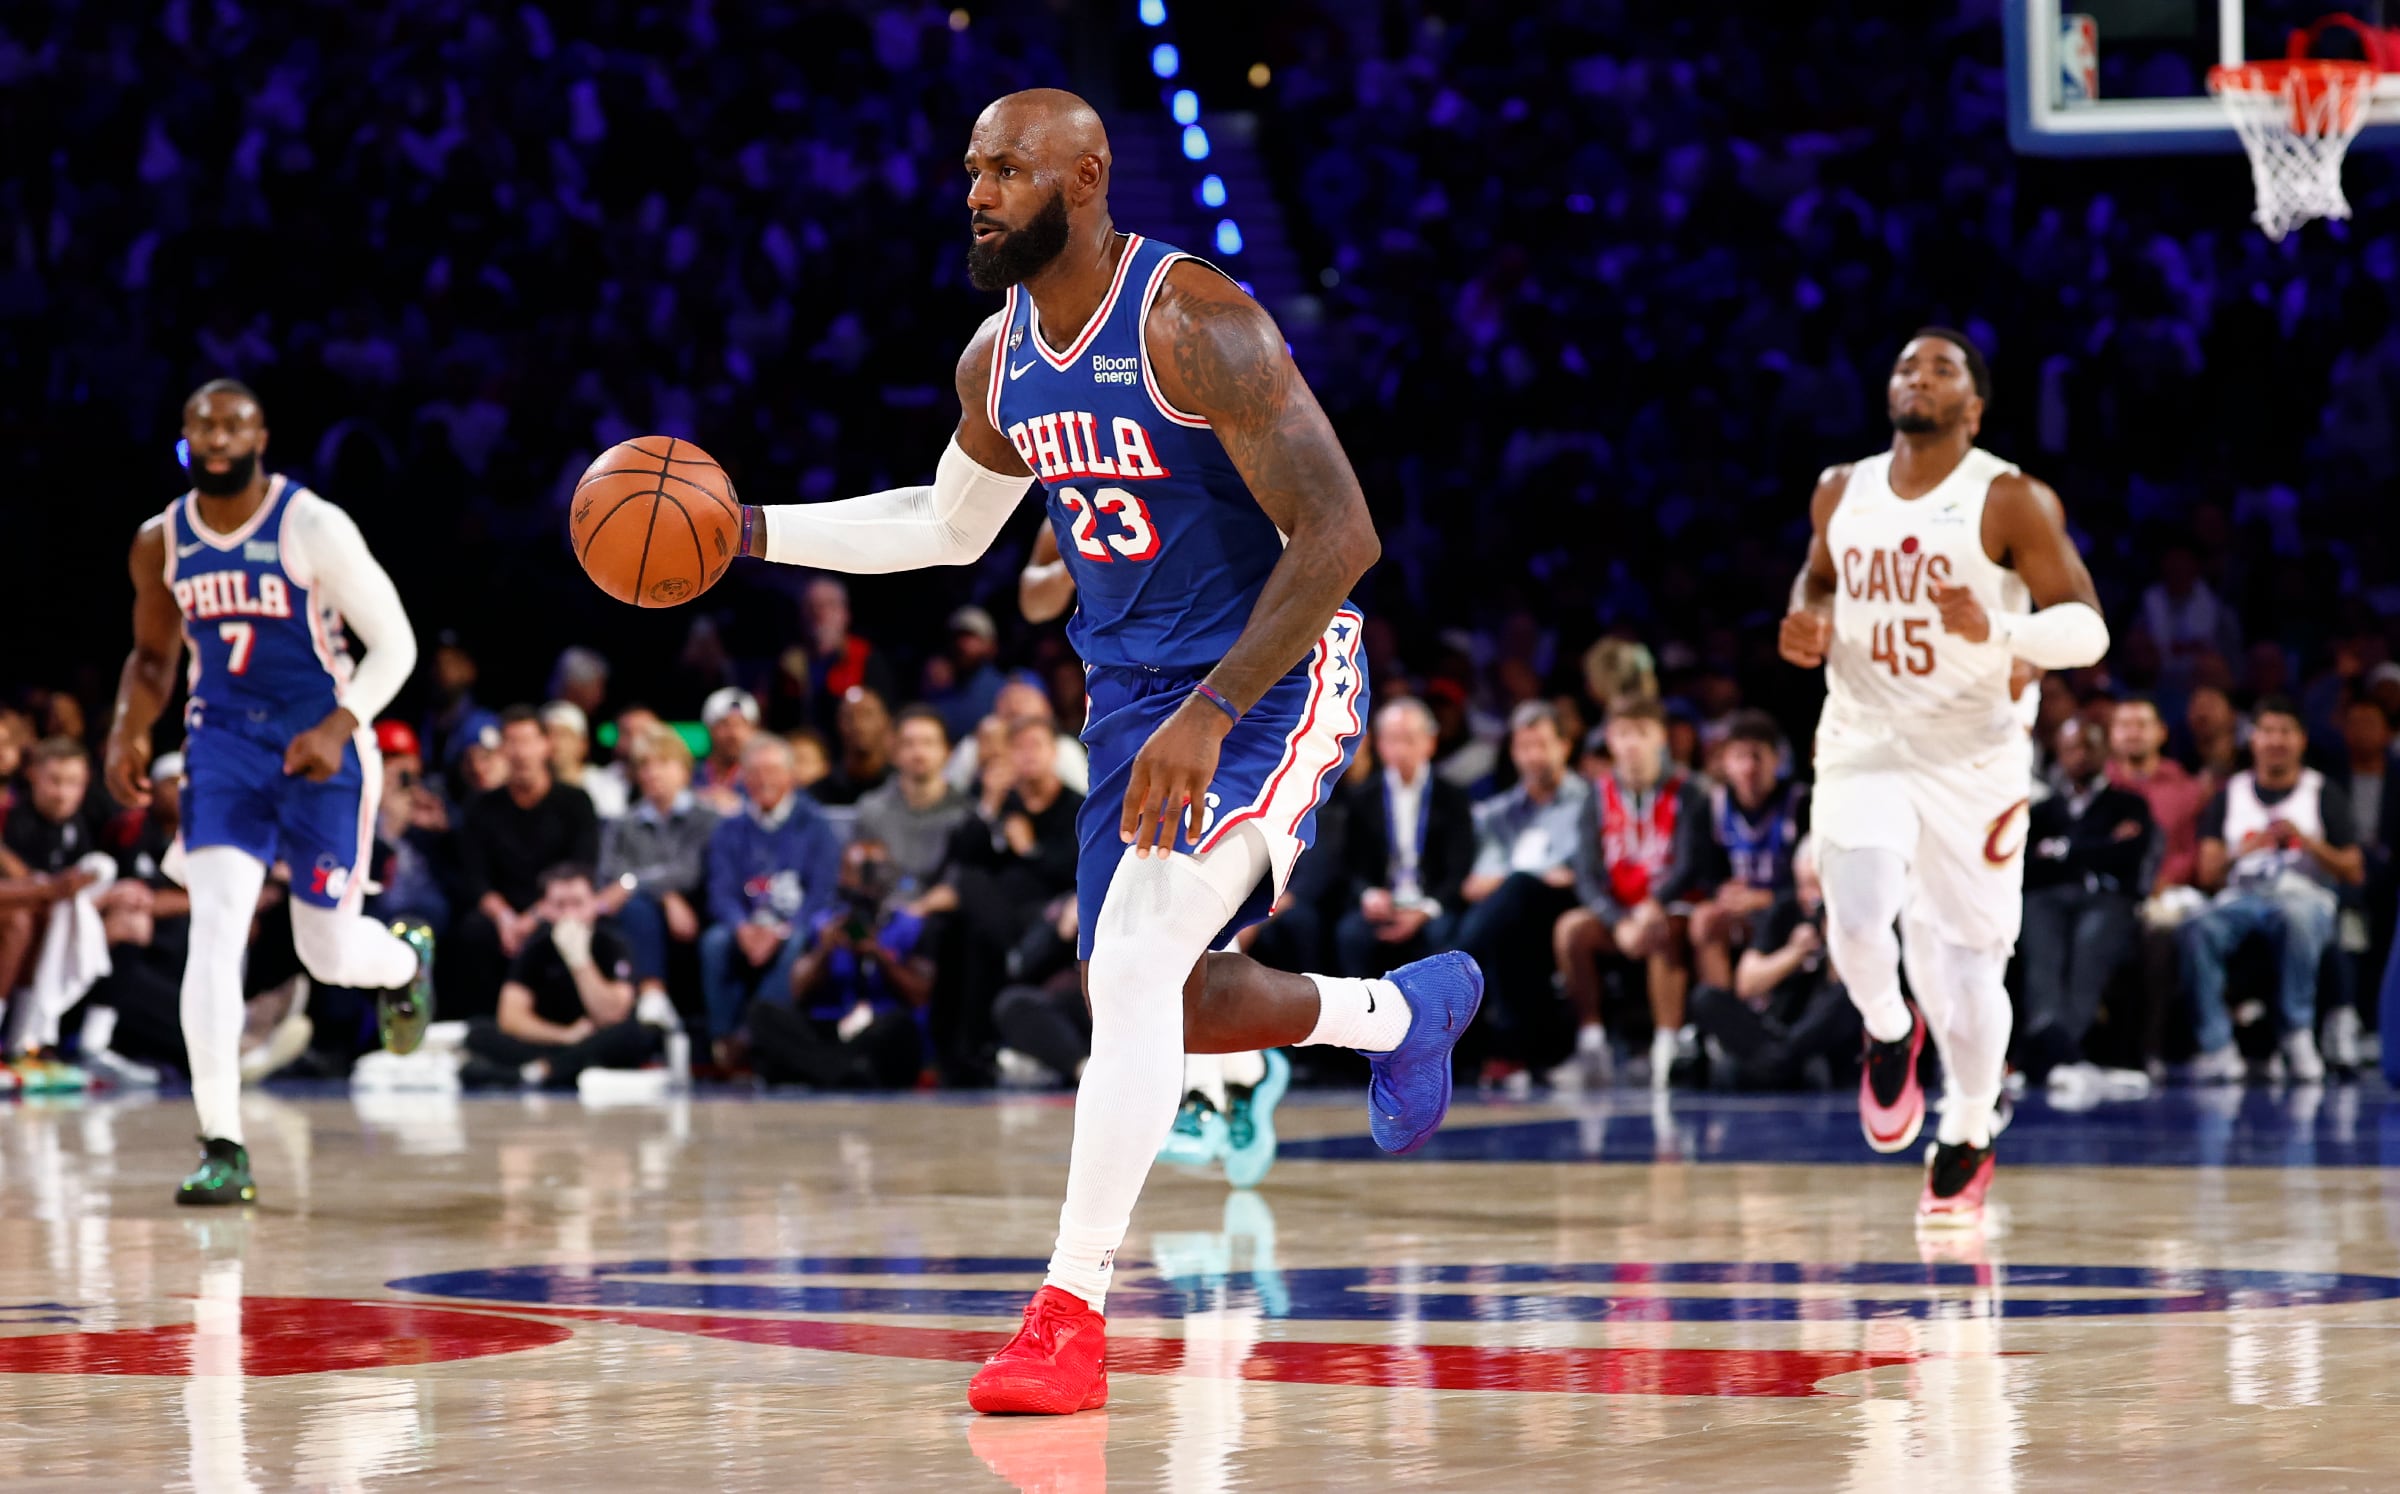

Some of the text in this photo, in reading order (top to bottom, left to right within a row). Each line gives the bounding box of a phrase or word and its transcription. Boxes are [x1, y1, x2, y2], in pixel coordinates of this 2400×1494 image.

[1092, 355, 1138, 371] Bloom
[1094, 371, 1138, 385] energy
[1007, 410, 1171, 484] PHILA
[1058, 487, 1161, 563] 23
[173, 570, 292, 620] PHILA
[1844, 544, 1951, 603] CAVS
[218, 623, 255, 676] 7
[1871, 618, 1936, 677] 45
